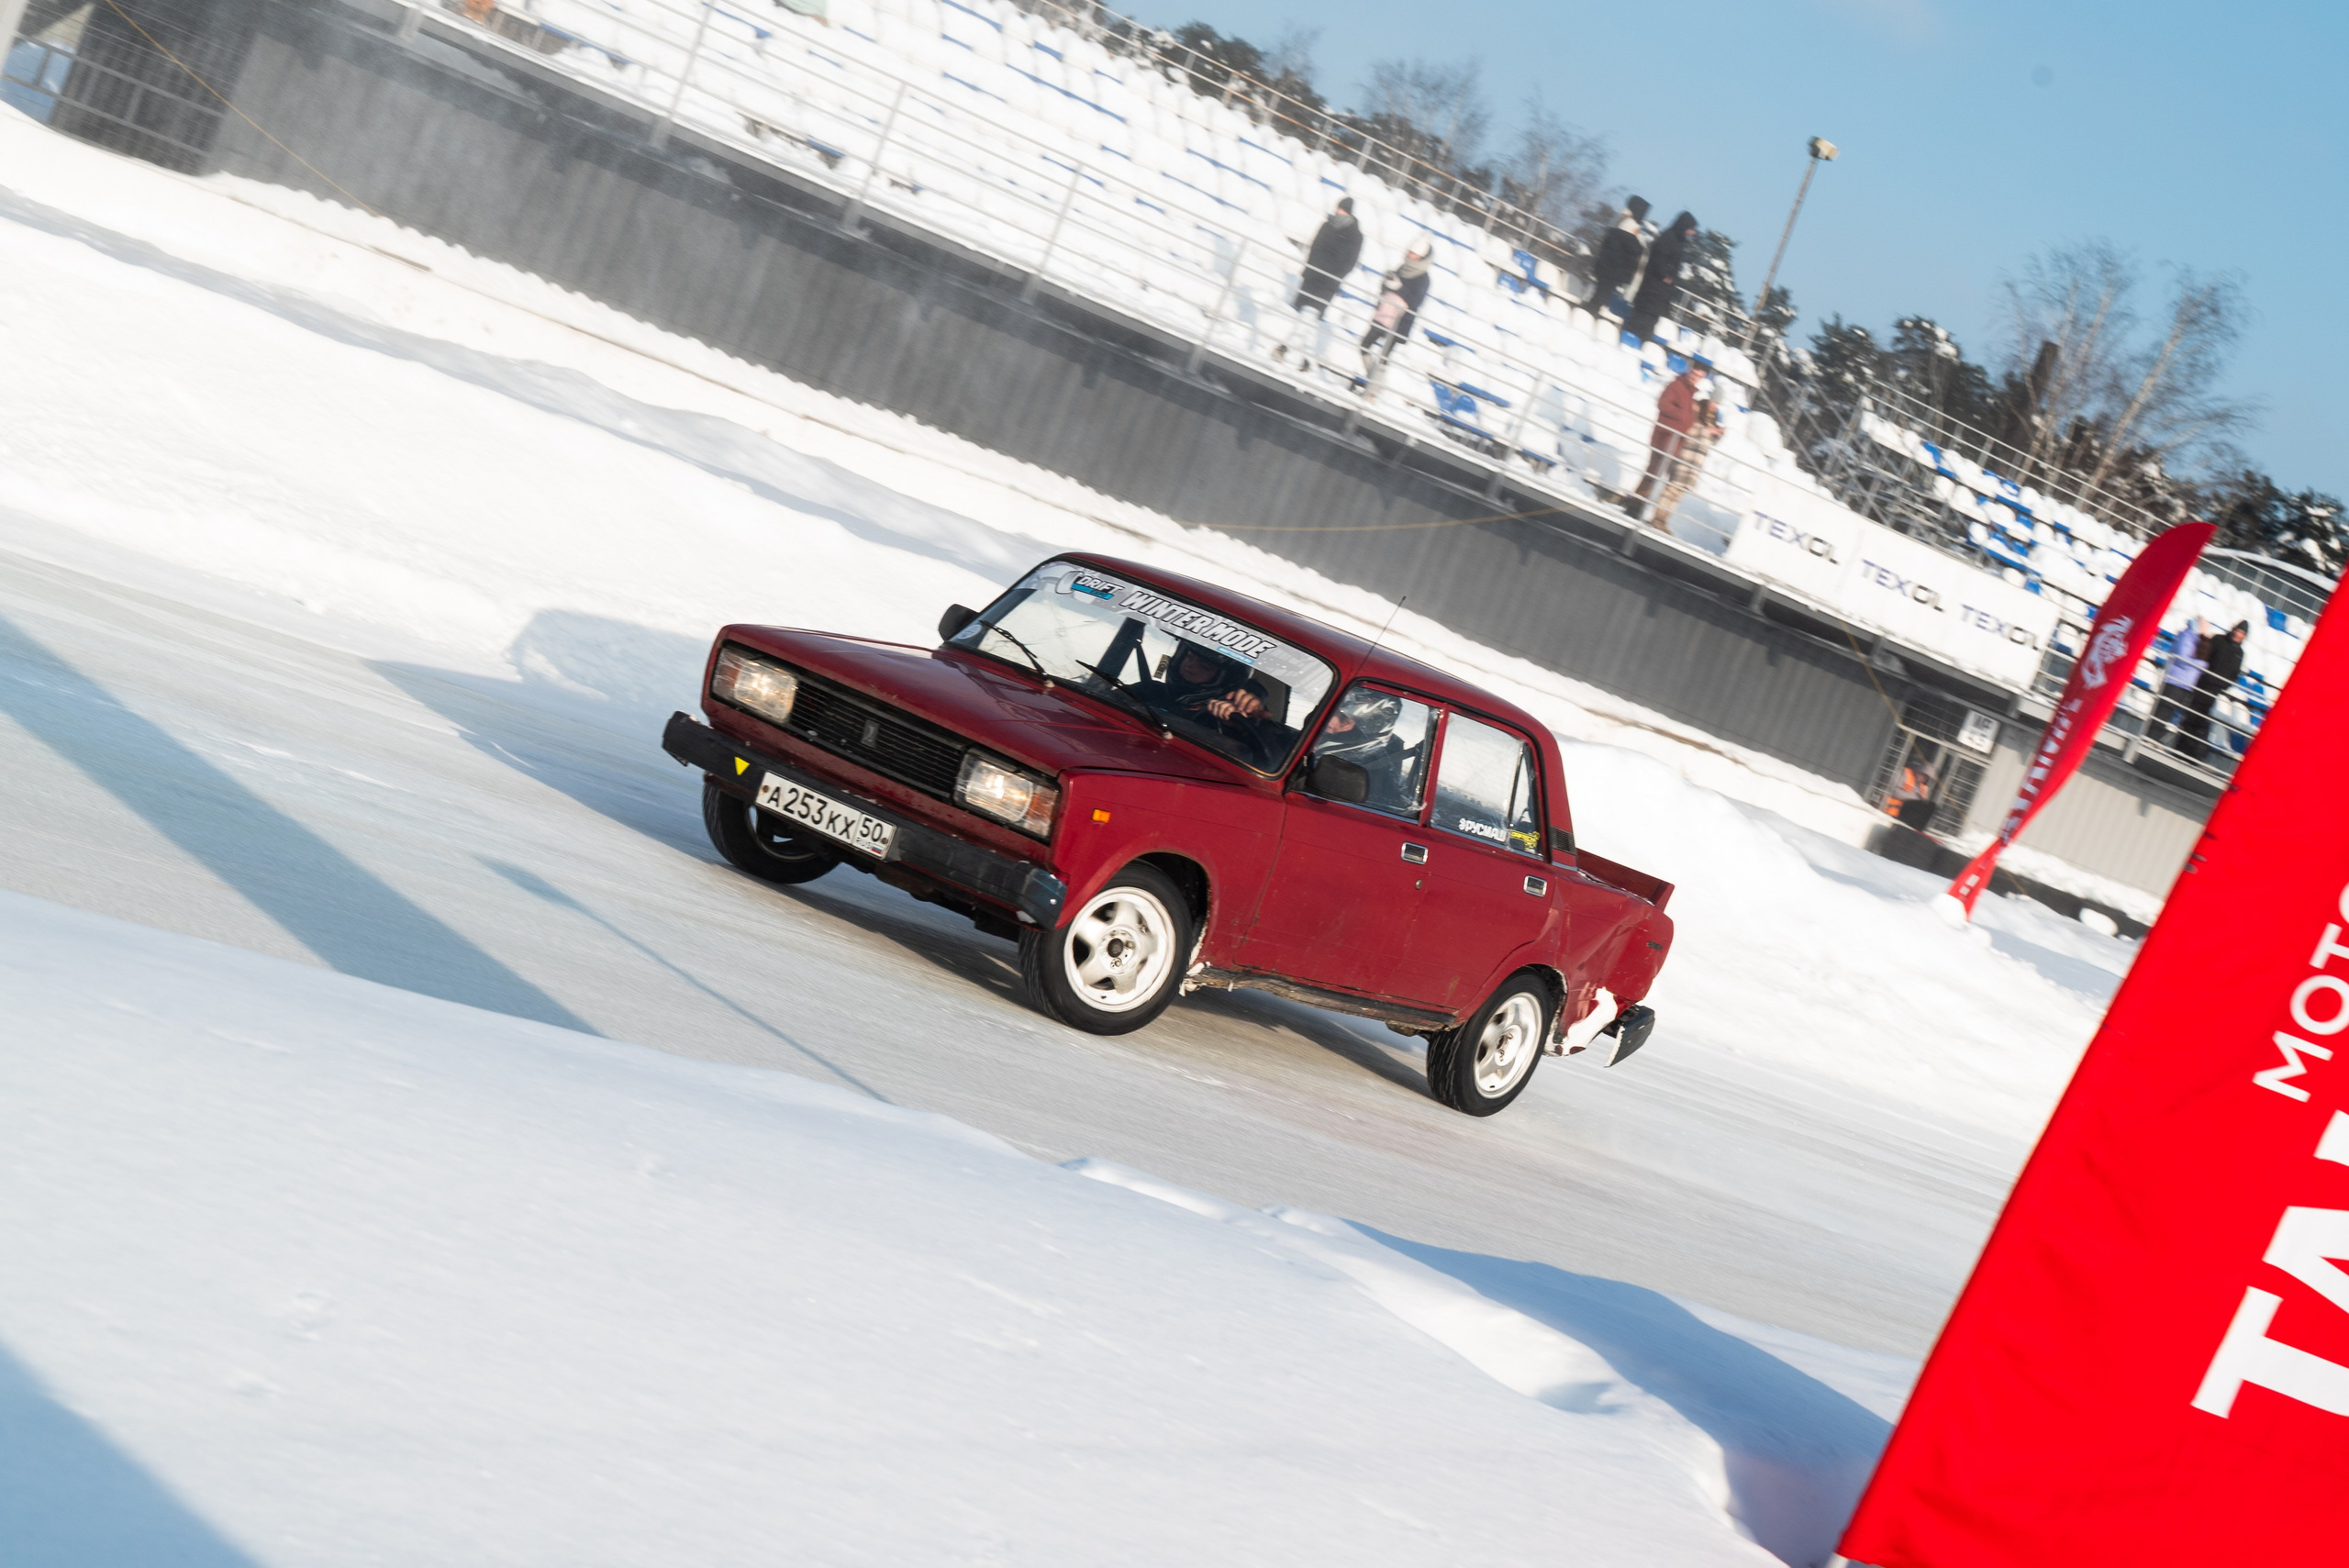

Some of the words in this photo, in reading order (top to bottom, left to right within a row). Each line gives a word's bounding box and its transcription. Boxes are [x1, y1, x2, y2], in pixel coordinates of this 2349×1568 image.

[1074, 575, 1126, 595] DRIFT
[1119, 590, 1215, 636] WINTER
[1201, 621, 1277, 659] MODE
[1753, 510, 1839, 565] TEXOL
[1862, 559, 1945, 613] TEXOL
[1961, 604, 2041, 651] TEXOL
[860, 817, 884, 843] 50
[2252, 881, 2349, 1103] MOT
[2190, 1108, 2349, 1418] TA
